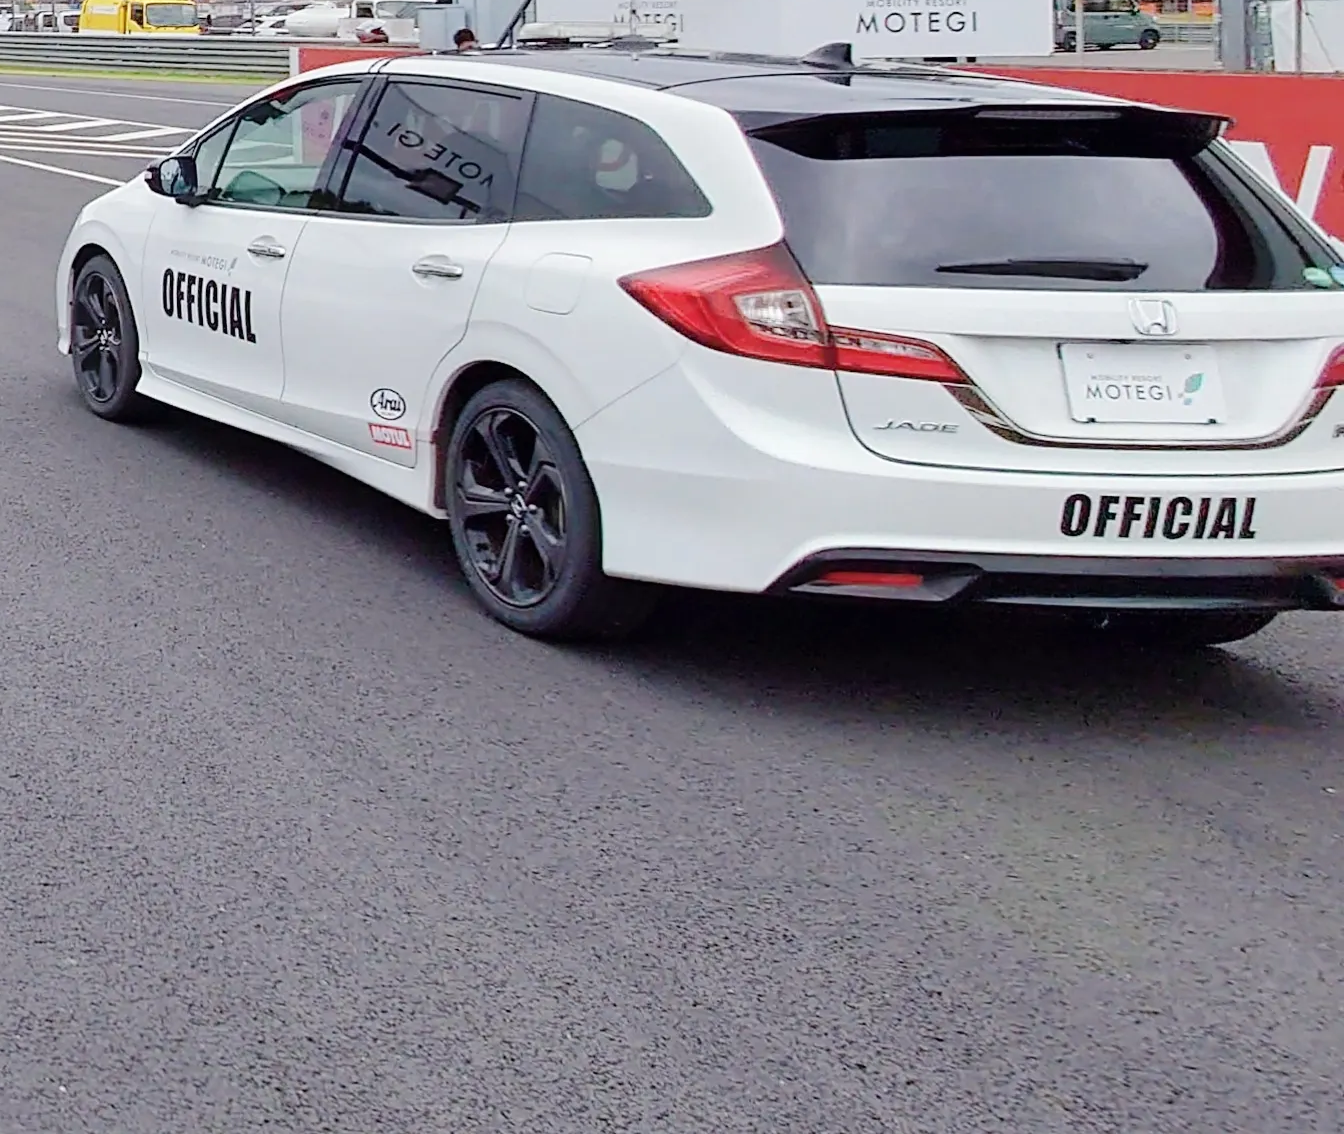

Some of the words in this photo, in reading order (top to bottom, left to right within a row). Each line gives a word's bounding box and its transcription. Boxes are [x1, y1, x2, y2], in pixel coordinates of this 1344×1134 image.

[856, 11, 977, 33] MOTEGI
[162, 268, 257, 344] OFFICIAL
[1085, 384, 1172, 401] MOTEGI
[873, 419, 960, 434] JADE
[1060, 494, 1257, 540] OFFICIAL
